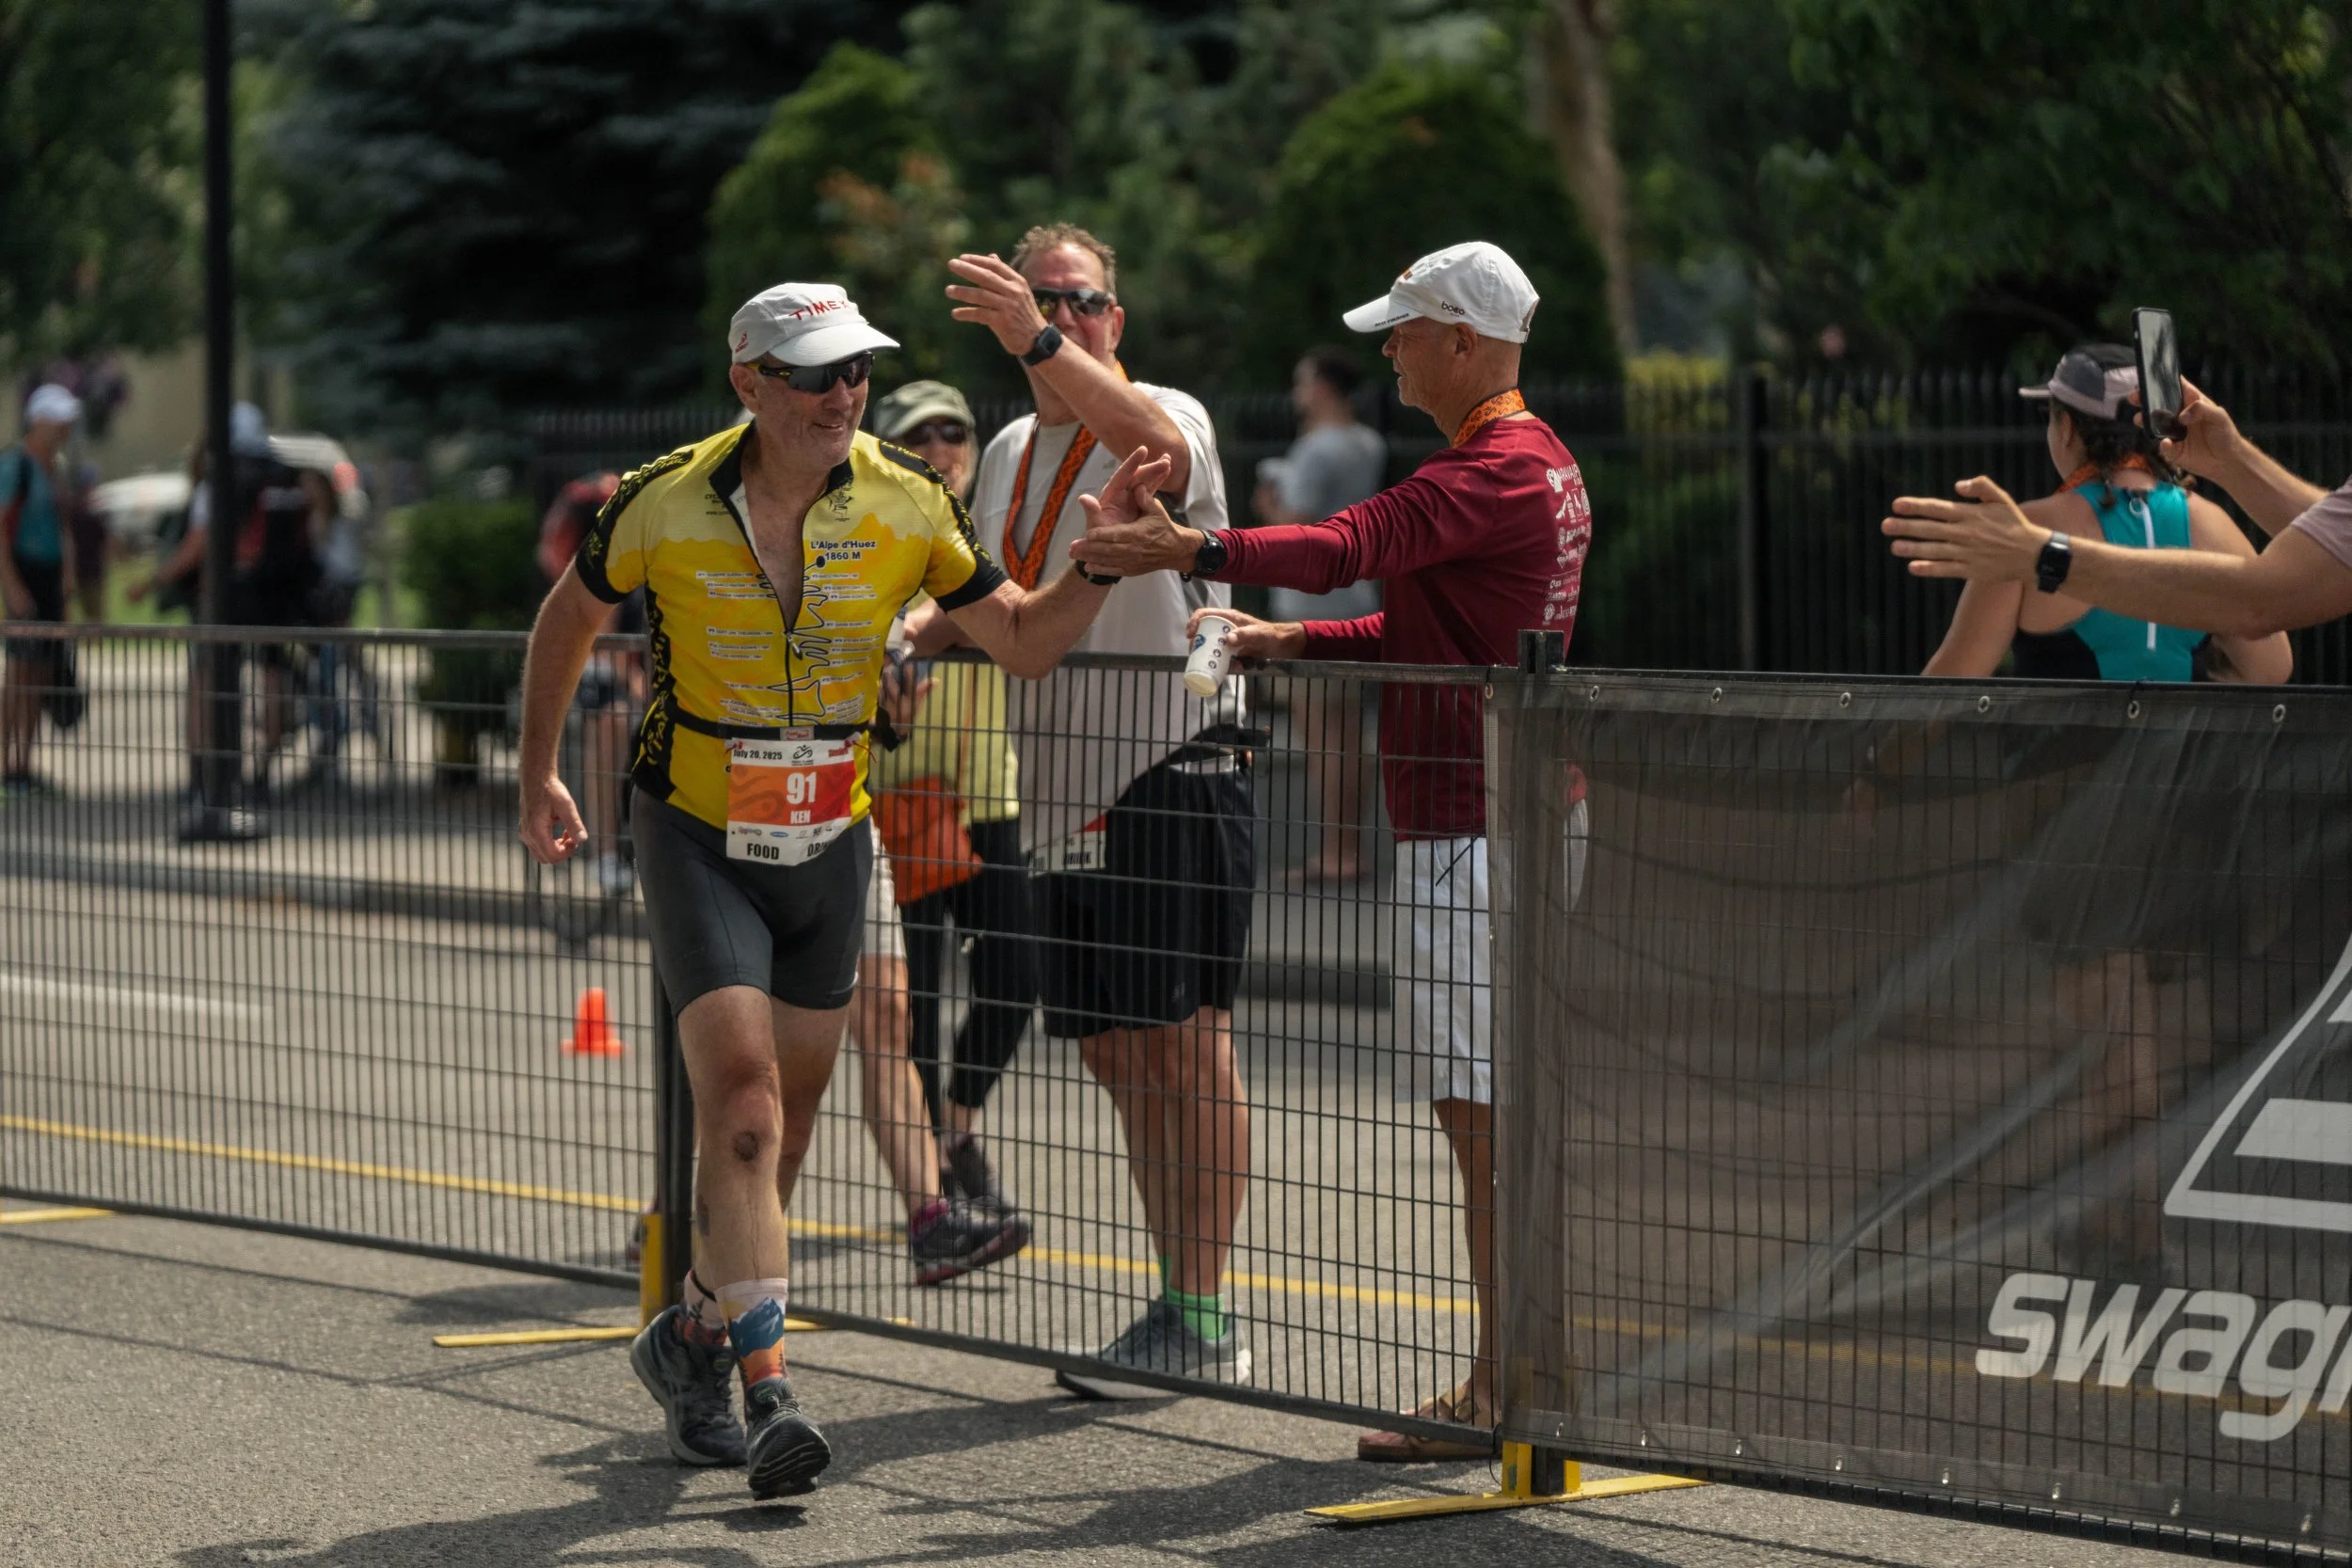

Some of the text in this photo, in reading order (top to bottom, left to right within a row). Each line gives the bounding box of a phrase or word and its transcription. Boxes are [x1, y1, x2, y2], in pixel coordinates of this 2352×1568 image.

[788, 300, 850, 321] TIMEX
[1441, 300, 1466, 315] boco
[810, 540, 877, 550] L'Alpe d'Huez
[825, 550, 862, 561] 1860 M
[763, 751, 783, 760] 2025
[787, 771, 817, 805] 91
[790, 810, 811, 824] KEN
[747, 842, 780, 860] FOOD
